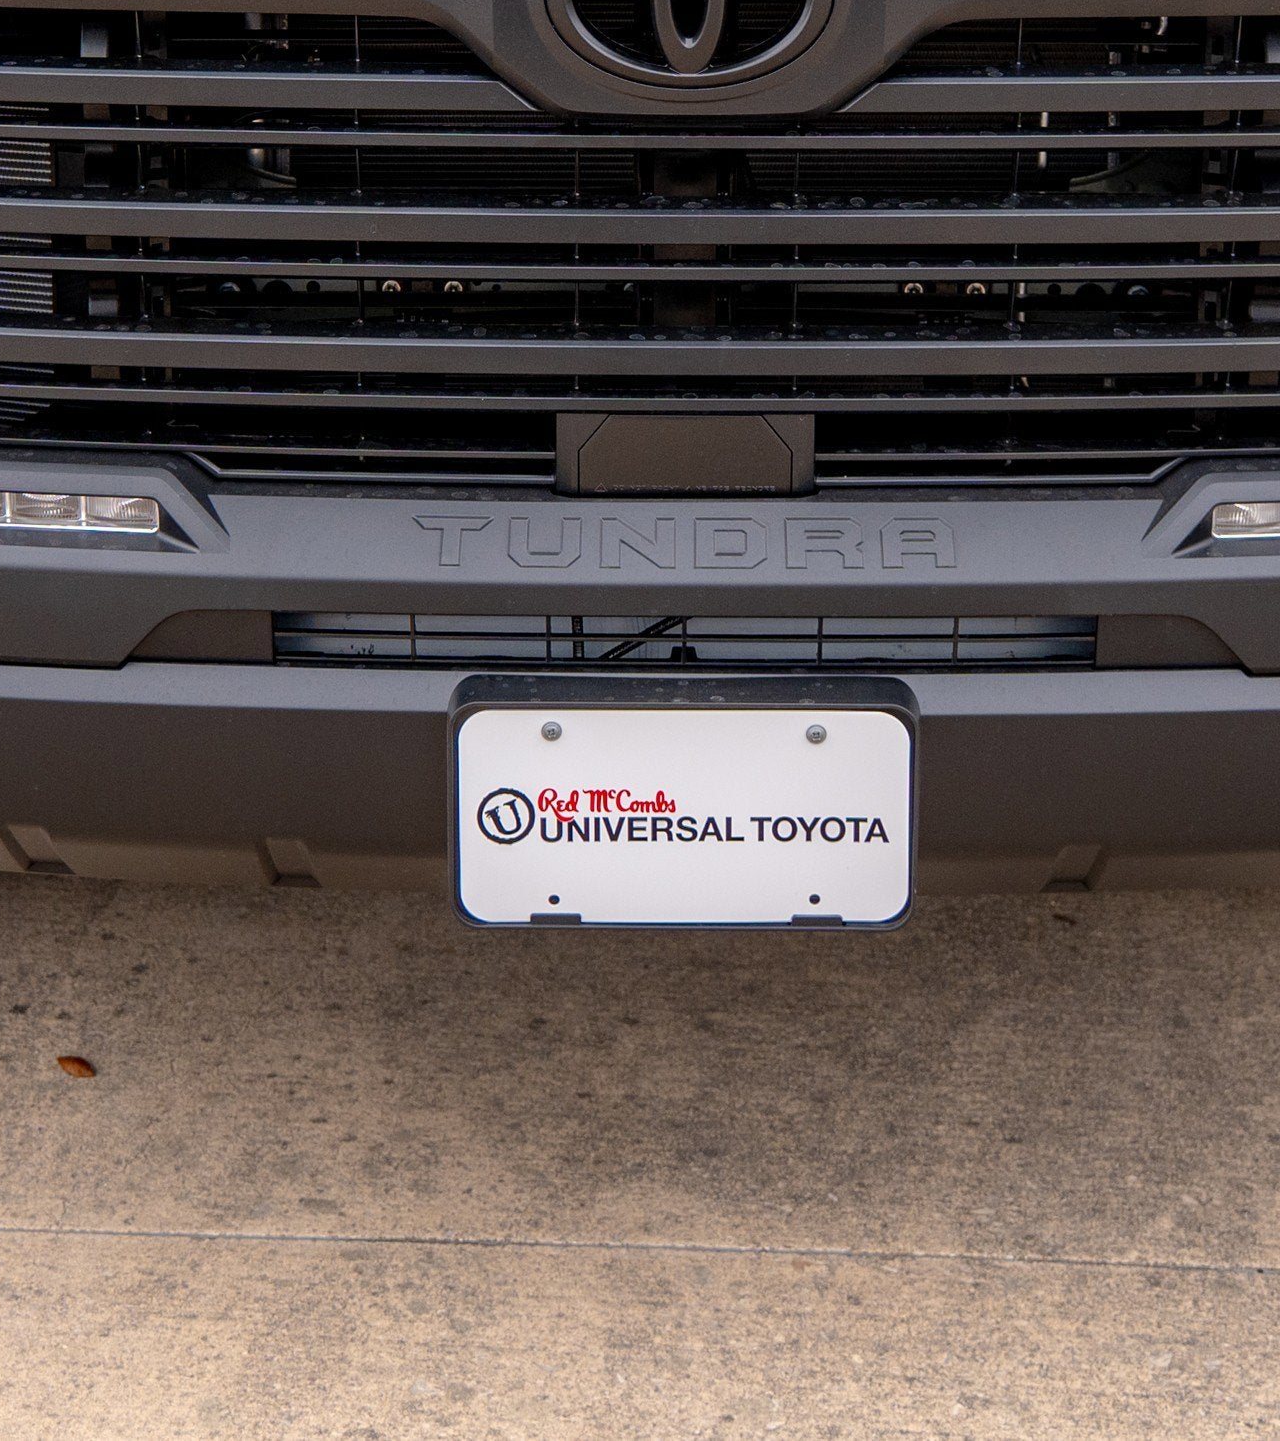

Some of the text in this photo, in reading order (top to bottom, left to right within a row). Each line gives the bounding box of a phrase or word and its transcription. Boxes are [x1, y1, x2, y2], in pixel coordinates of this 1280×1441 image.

[411, 515, 957, 571] TUNDRA
[537, 788, 579, 822] Red
[540, 816, 890, 844] UNIVERSAL TOYOTA
